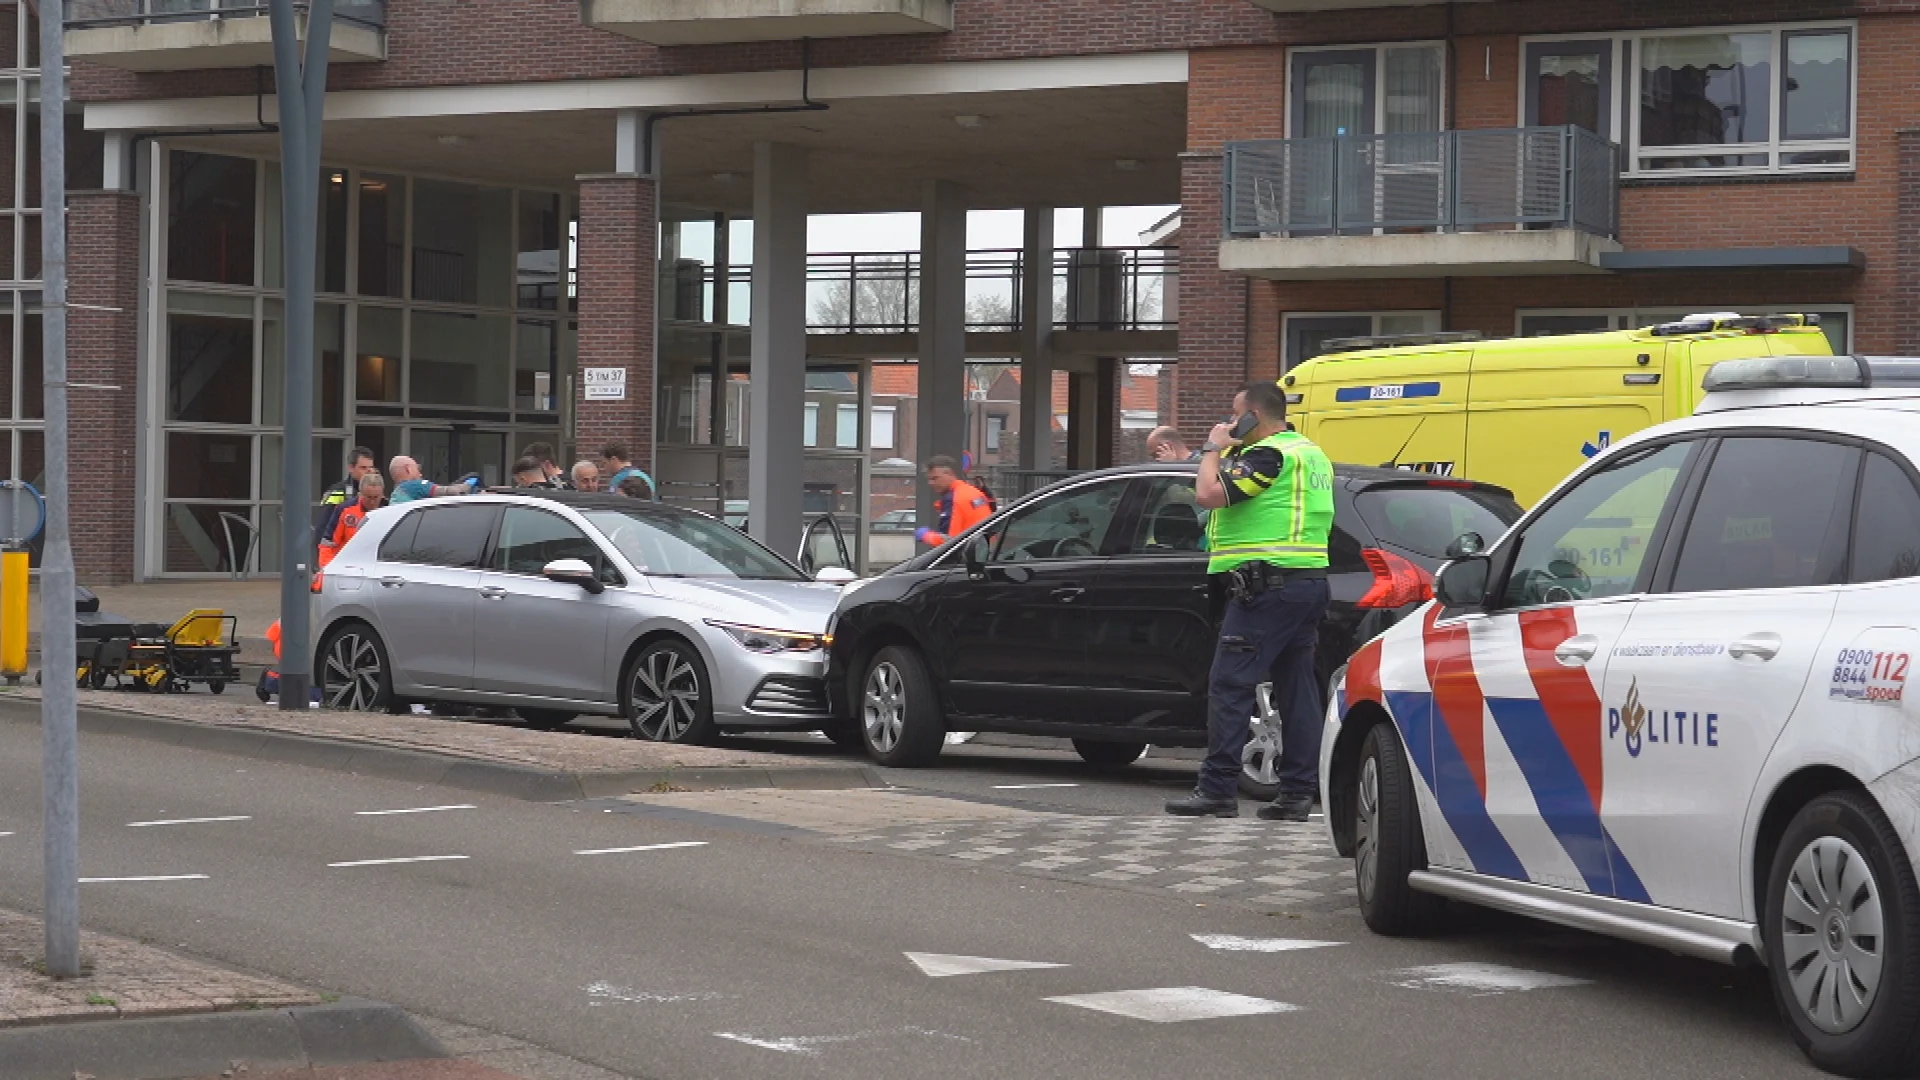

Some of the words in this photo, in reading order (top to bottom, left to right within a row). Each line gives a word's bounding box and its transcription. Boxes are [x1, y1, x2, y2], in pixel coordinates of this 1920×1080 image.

[587, 369, 594, 382] 5
[611, 370, 623, 382] 37
[1372, 386, 1402, 397] 20-161
[1837, 648, 1873, 666] 0900
[1872, 651, 1910, 681] 112
[1833, 666, 1867, 684] 8844
[1608, 706, 1719, 758] POLITIE
